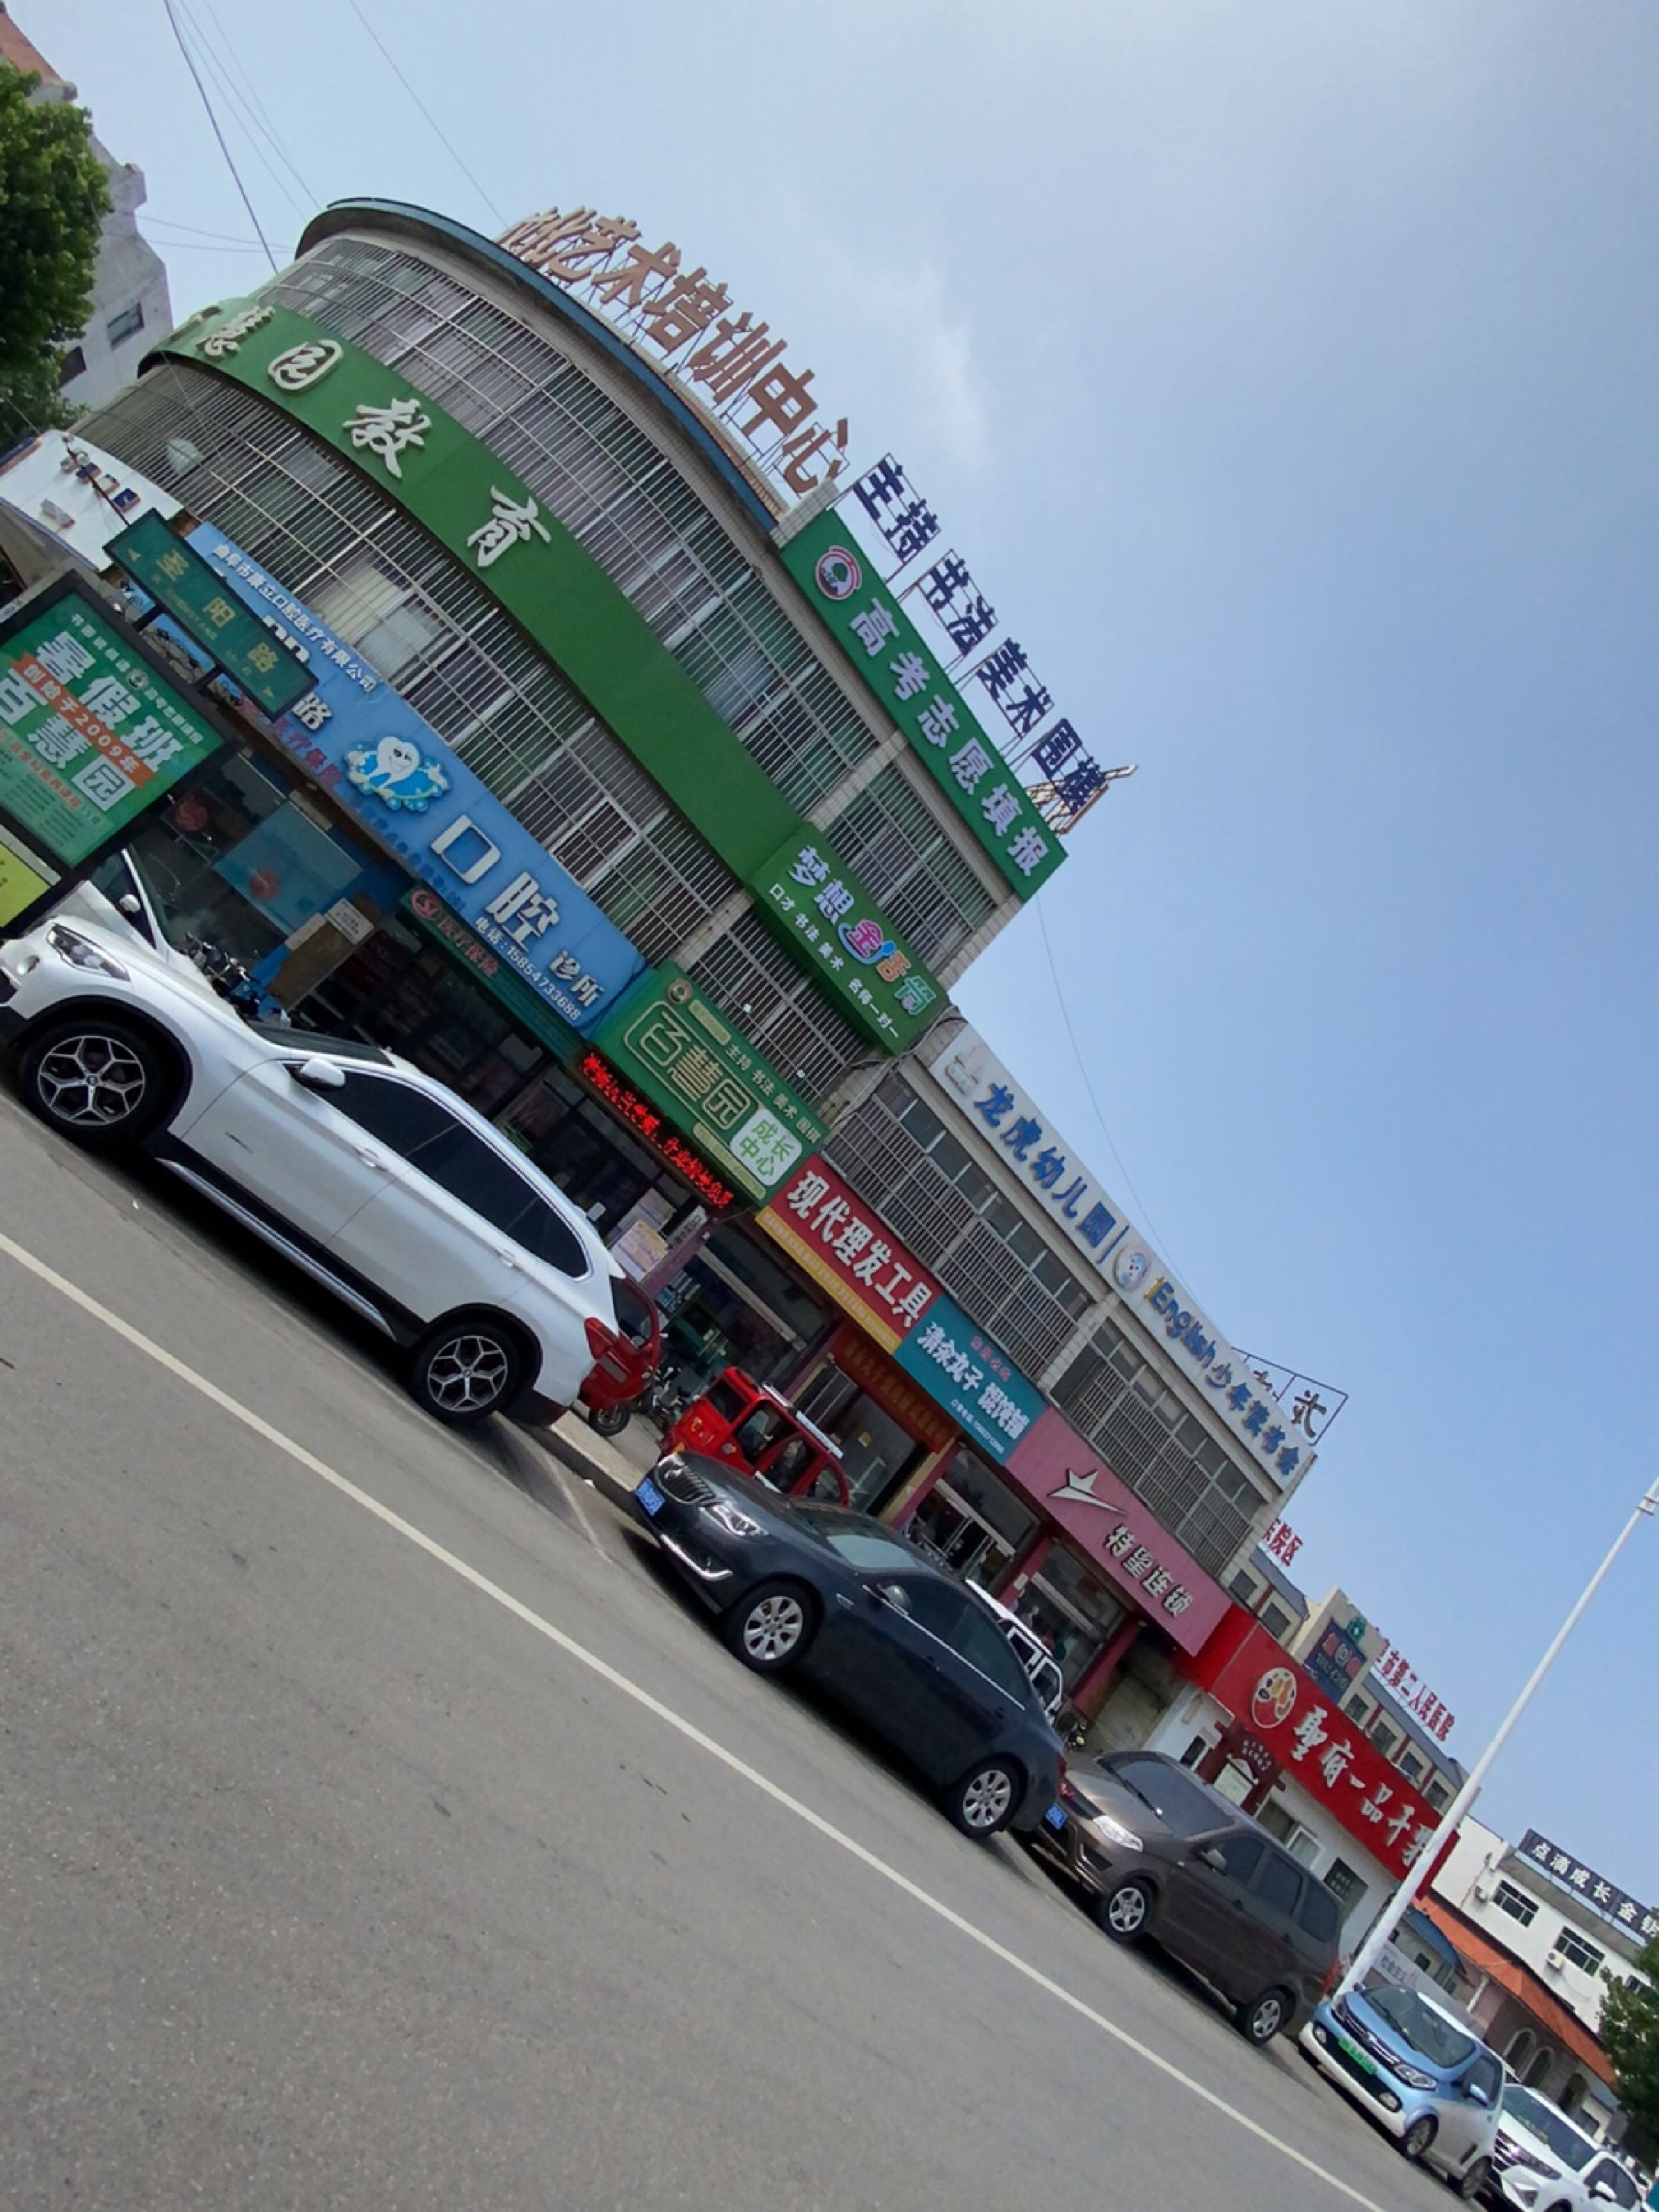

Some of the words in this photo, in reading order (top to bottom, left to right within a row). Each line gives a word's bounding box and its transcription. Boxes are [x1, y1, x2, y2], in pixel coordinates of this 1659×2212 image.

[154, 546, 283, 677] 圣阳路
[211, 540, 379, 694] 曲阜市康立口腔医疗有限公司
[850, 453, 942, 564] 主持
[915, 550, 1002, 657] 书法
[974, 637, 1057, 737] 美术
[1030, 719, 1110, 815] 围棋
[0, 667, 136, 812] 百慧园
[22, 663, 141, 775] 创始于2009年
[31, 629, 186, 773] 暑假班
[849, 595, 1054, 878] 高考志愿填报
[767, 882, 796, 913] 口才
[792, 911, 821, 943] 书法
[817, 941, 846, 973] 美术
[846, 975, 903, 1042] 名师一对一
[636, 1009, 755, 1133] 百慧园
[723, 1043, 753, 1073] 主持
[747, 1067, 777, 1098] 书法
[771, 1091, 800, 1121] 美术
[794, 1116, 822, 1144] 围棋
[750, 1115, 796, 1163] 成长
[733, 1132, 782, 1181] 中心
[970, 1077, 1121, 1249] 龙虎幼儿园
[783, 1169, 936, 1329] 现代理发工具
